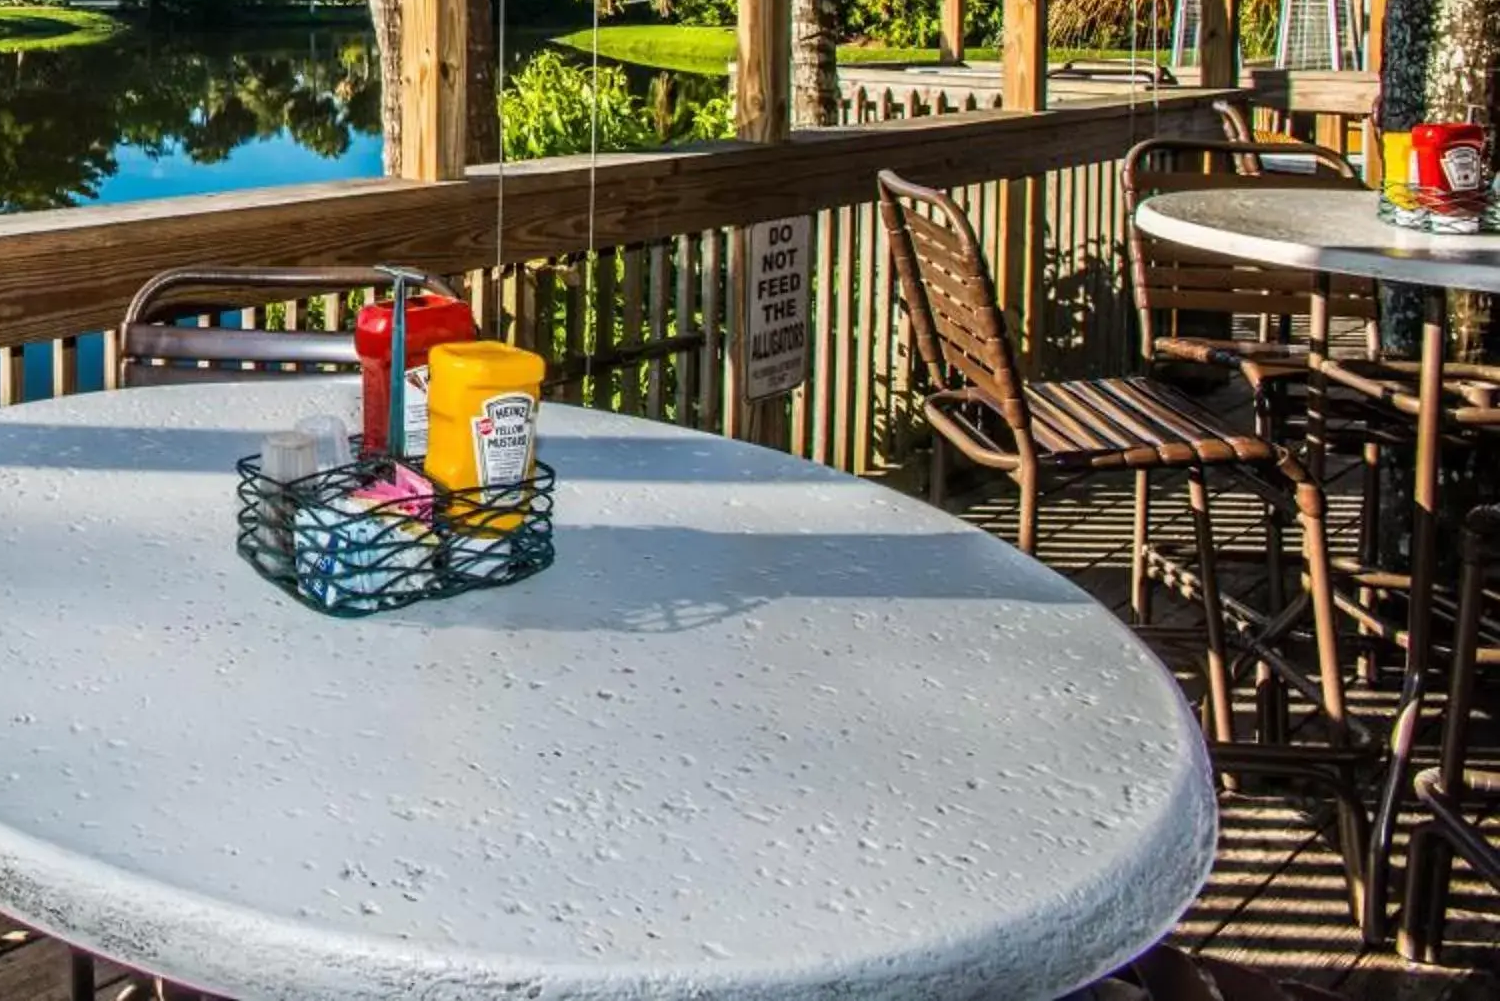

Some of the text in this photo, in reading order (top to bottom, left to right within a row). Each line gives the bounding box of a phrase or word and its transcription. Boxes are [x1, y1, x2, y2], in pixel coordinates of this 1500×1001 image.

[769, 225, 792, 245] DO
[762, 249, 798, 273] NOT
[757, 273, 801, 300] FEED
[762, 299, 796, 323] THE
[752, 321, 804, 361] ALLIGATORS
[495, 406, 525, 419] HEINZ
[488, 435, 527, 448] MUSTARD
